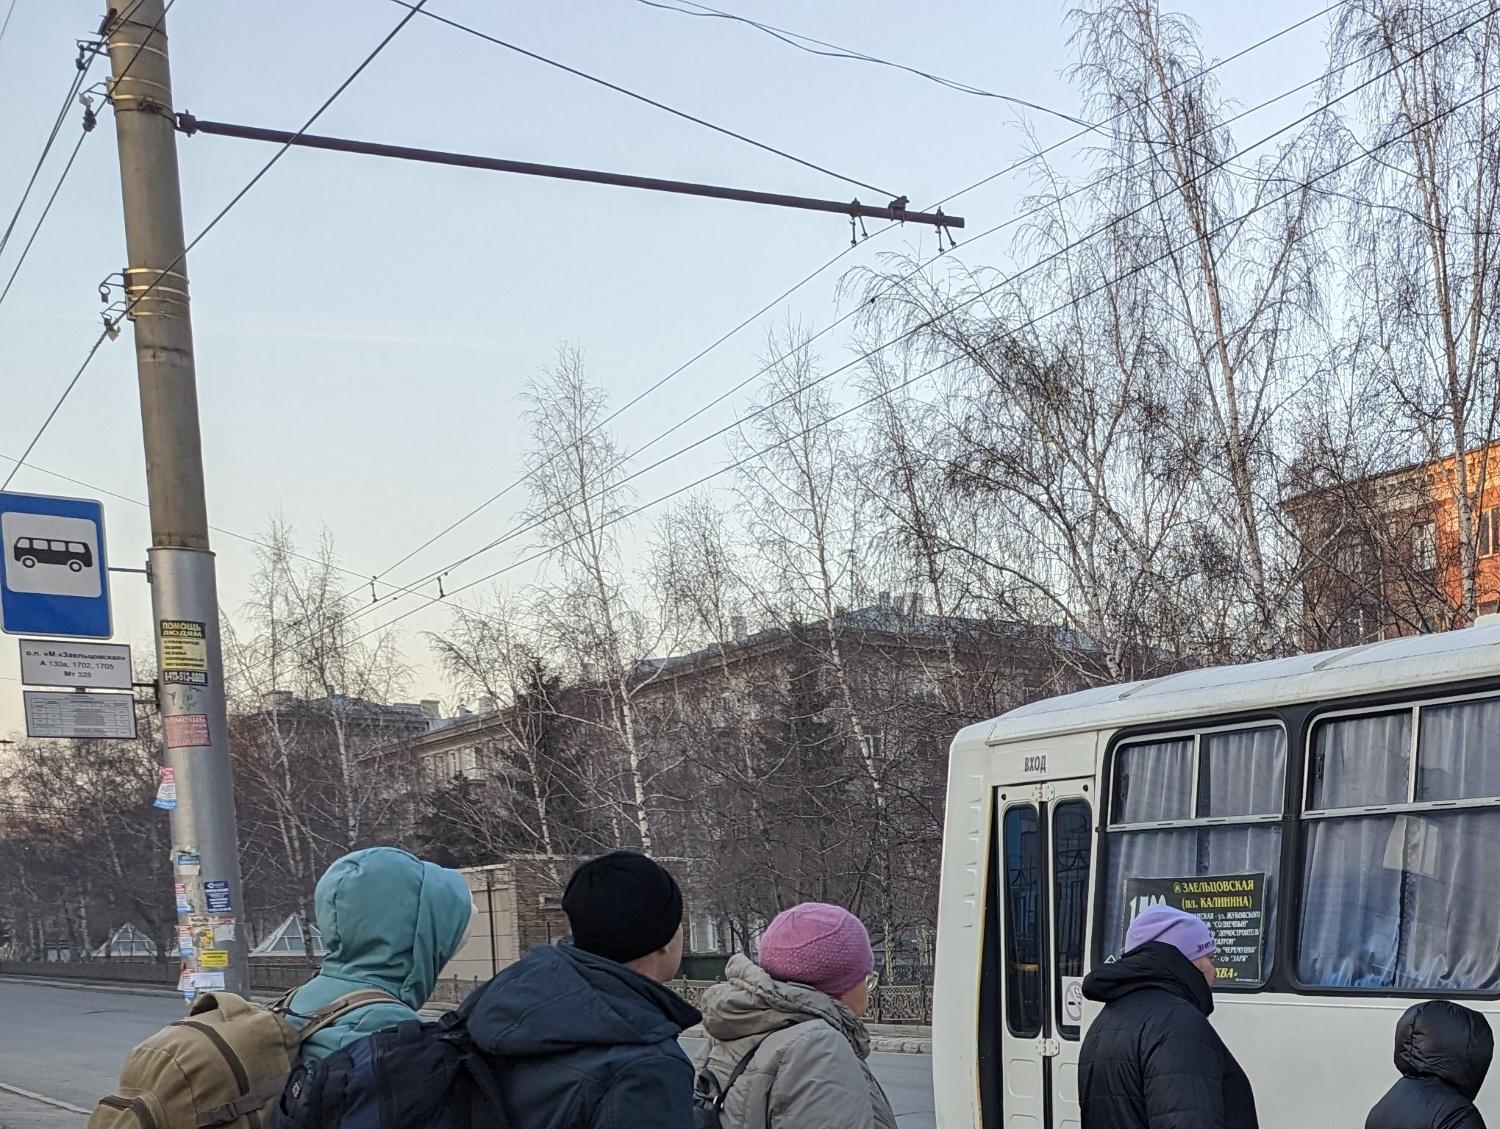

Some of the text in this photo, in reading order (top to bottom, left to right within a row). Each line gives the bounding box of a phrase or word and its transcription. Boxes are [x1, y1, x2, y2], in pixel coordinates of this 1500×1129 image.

[162, 622, 202, 632] ПОМОЩЬ
[1024, 754, 1046, 773] ВХОД
[1182, 880, 1254, 893] ЗАЕЛЬЦОВСКАЯ
[1200, 896, 1252, 910] КАЛИНИНА)
